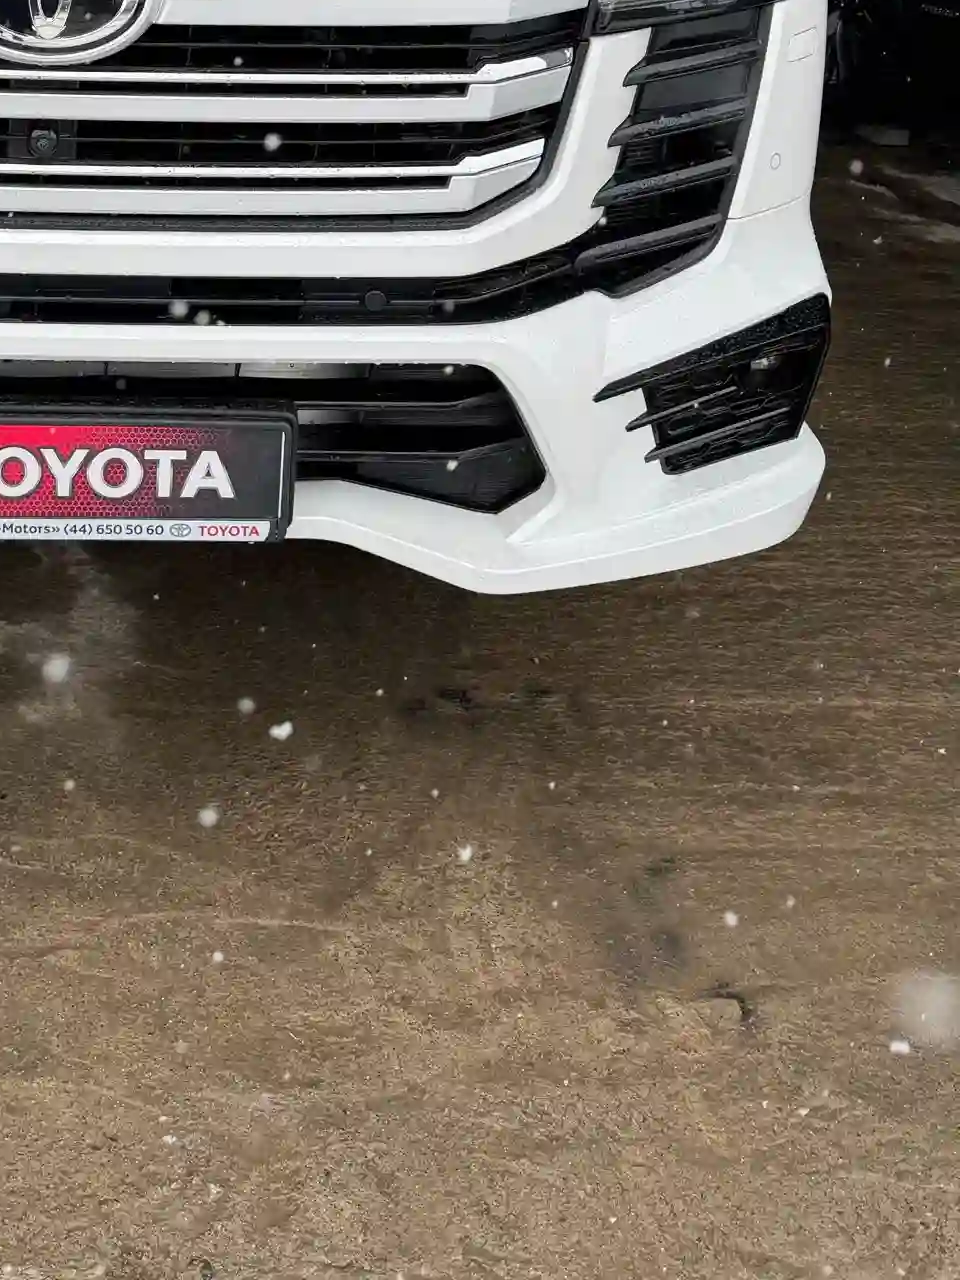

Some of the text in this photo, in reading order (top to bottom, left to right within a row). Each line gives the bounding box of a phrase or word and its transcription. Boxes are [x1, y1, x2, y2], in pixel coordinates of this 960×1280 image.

[63, 523, 93, 536] (44)
[96, 524, 122, 535] 650
[126, 524, 143, 535] 50
[146, 525, 165, 536] 60
[198, 525, 260, 537] TOYOTA
